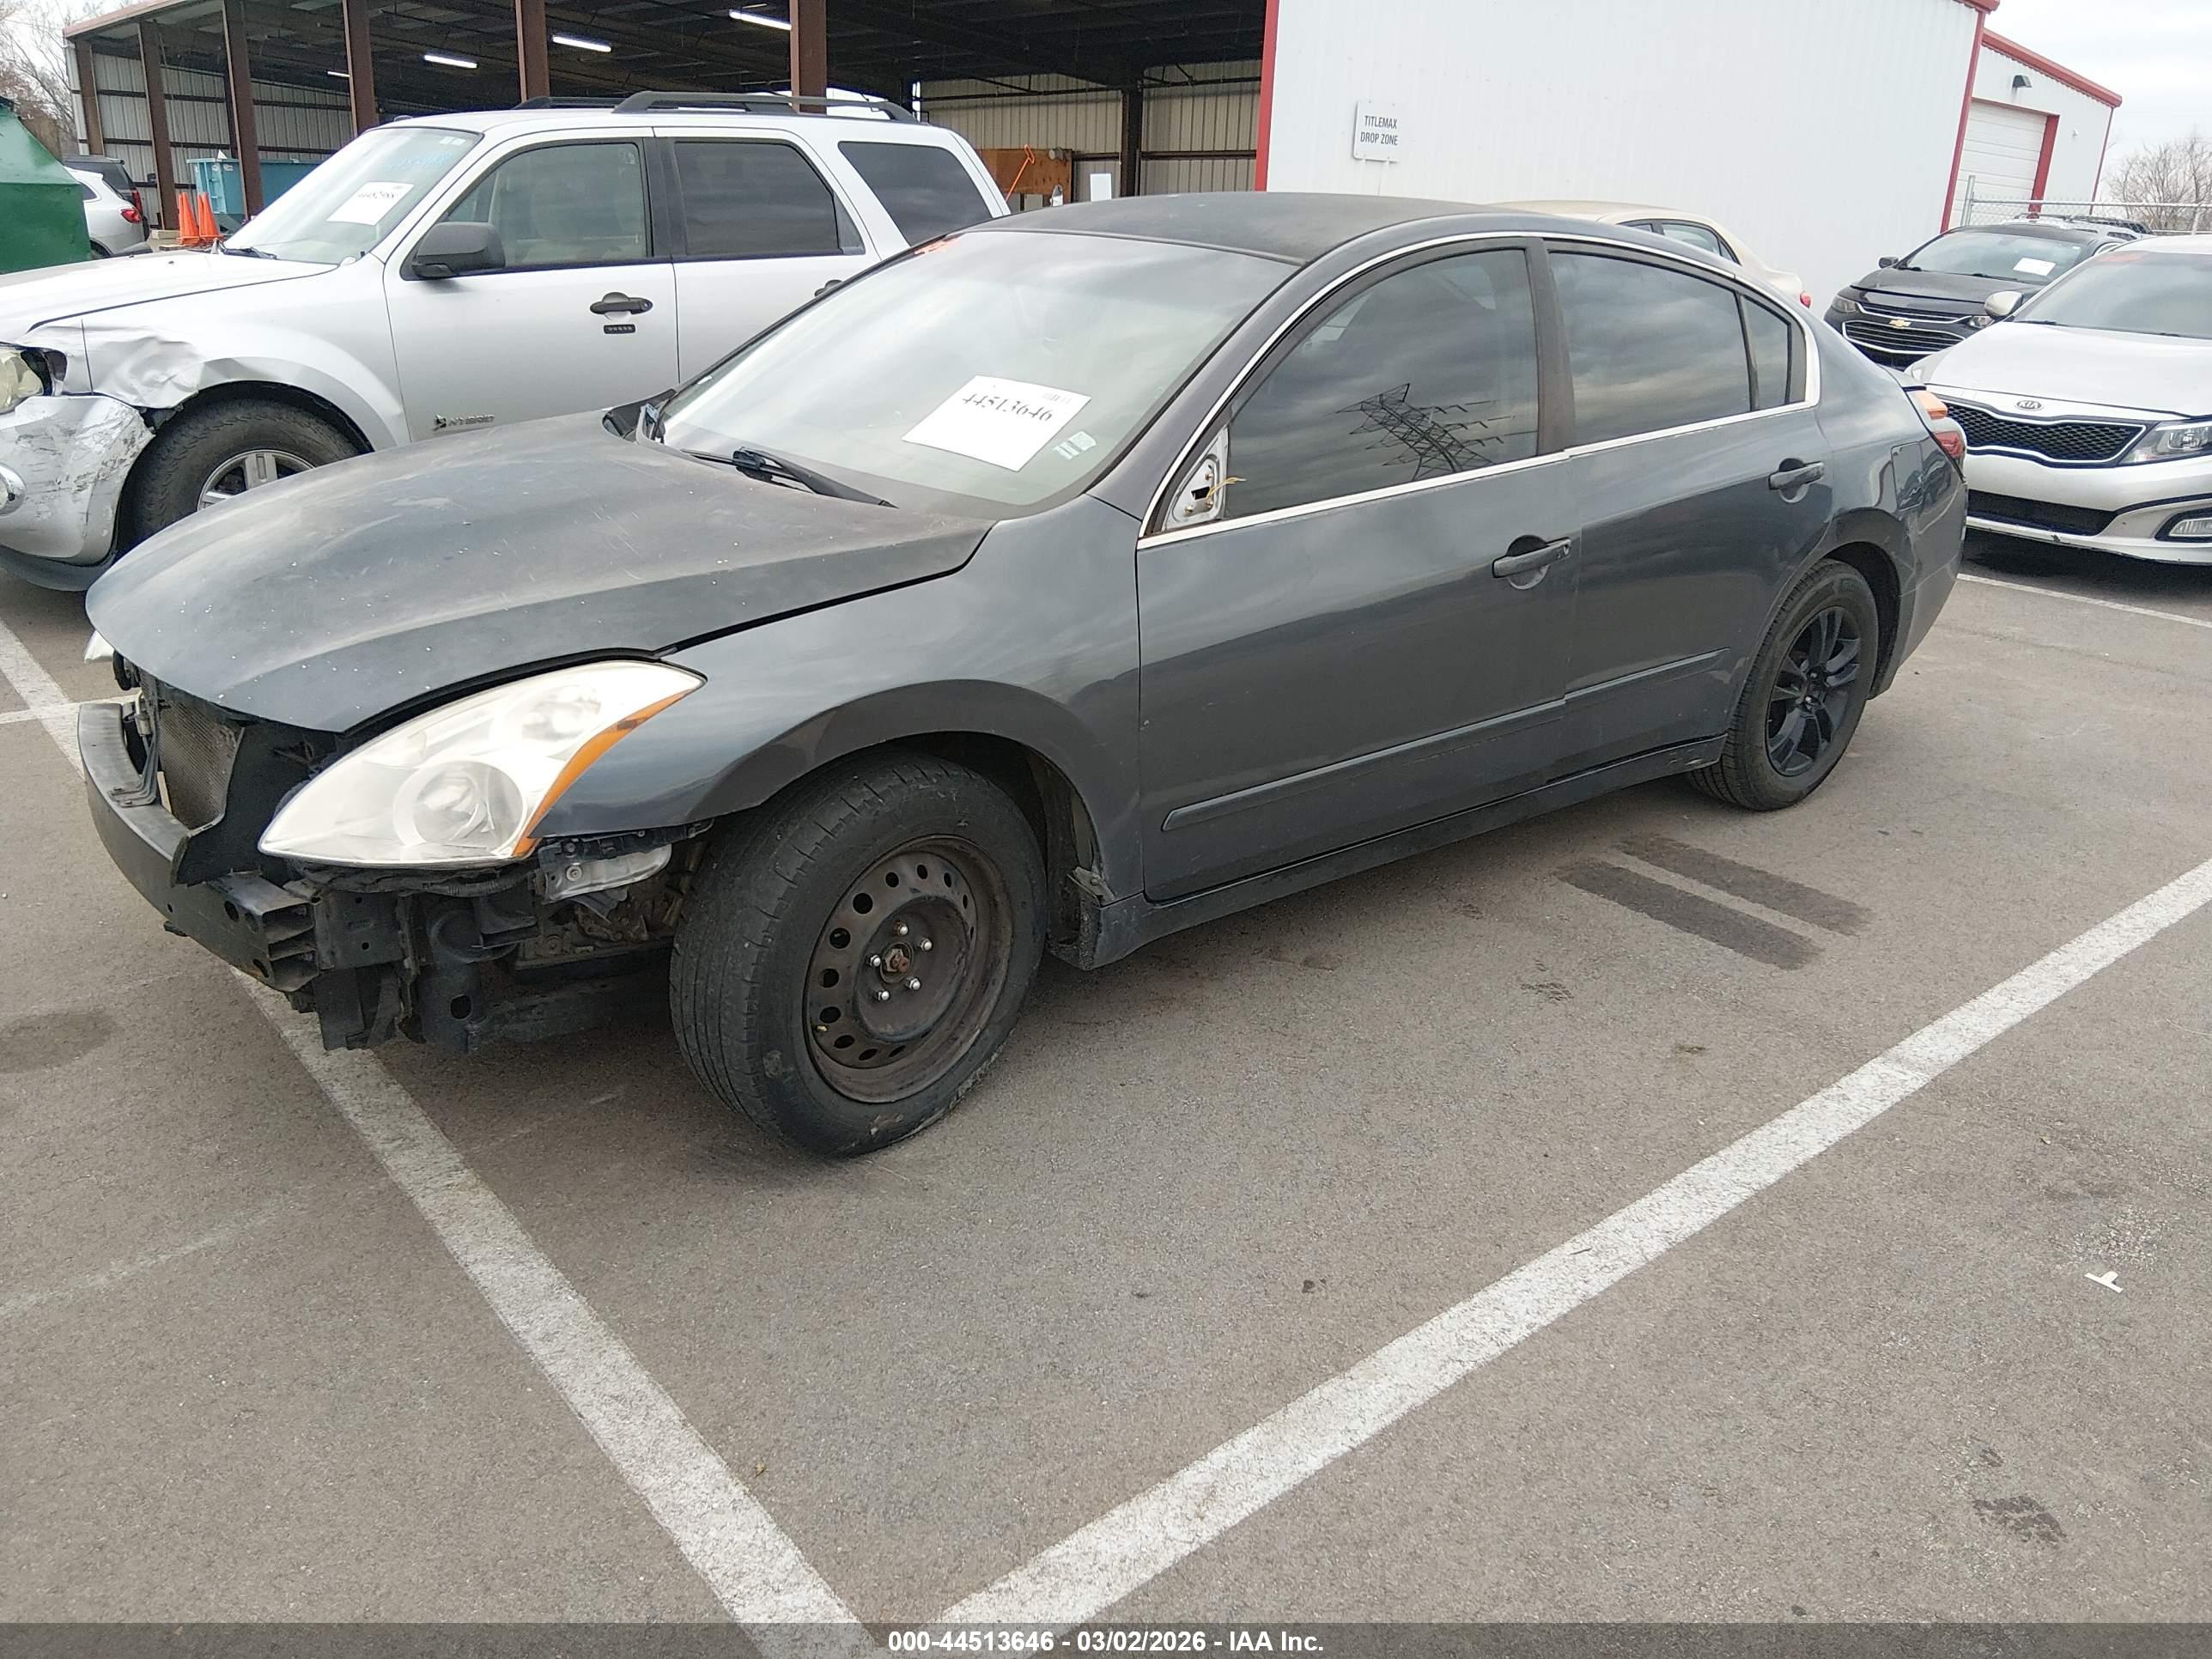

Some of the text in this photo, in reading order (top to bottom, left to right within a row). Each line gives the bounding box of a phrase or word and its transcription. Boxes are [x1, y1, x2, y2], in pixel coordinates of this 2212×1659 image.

[1364, 115, 1398, 130] TITLEMAX
[1360, 131, 1399, 146] DROP ZONE
[962, 392, 1054, 422] 44513646
[2018, 400, 2039, 409] KIA
